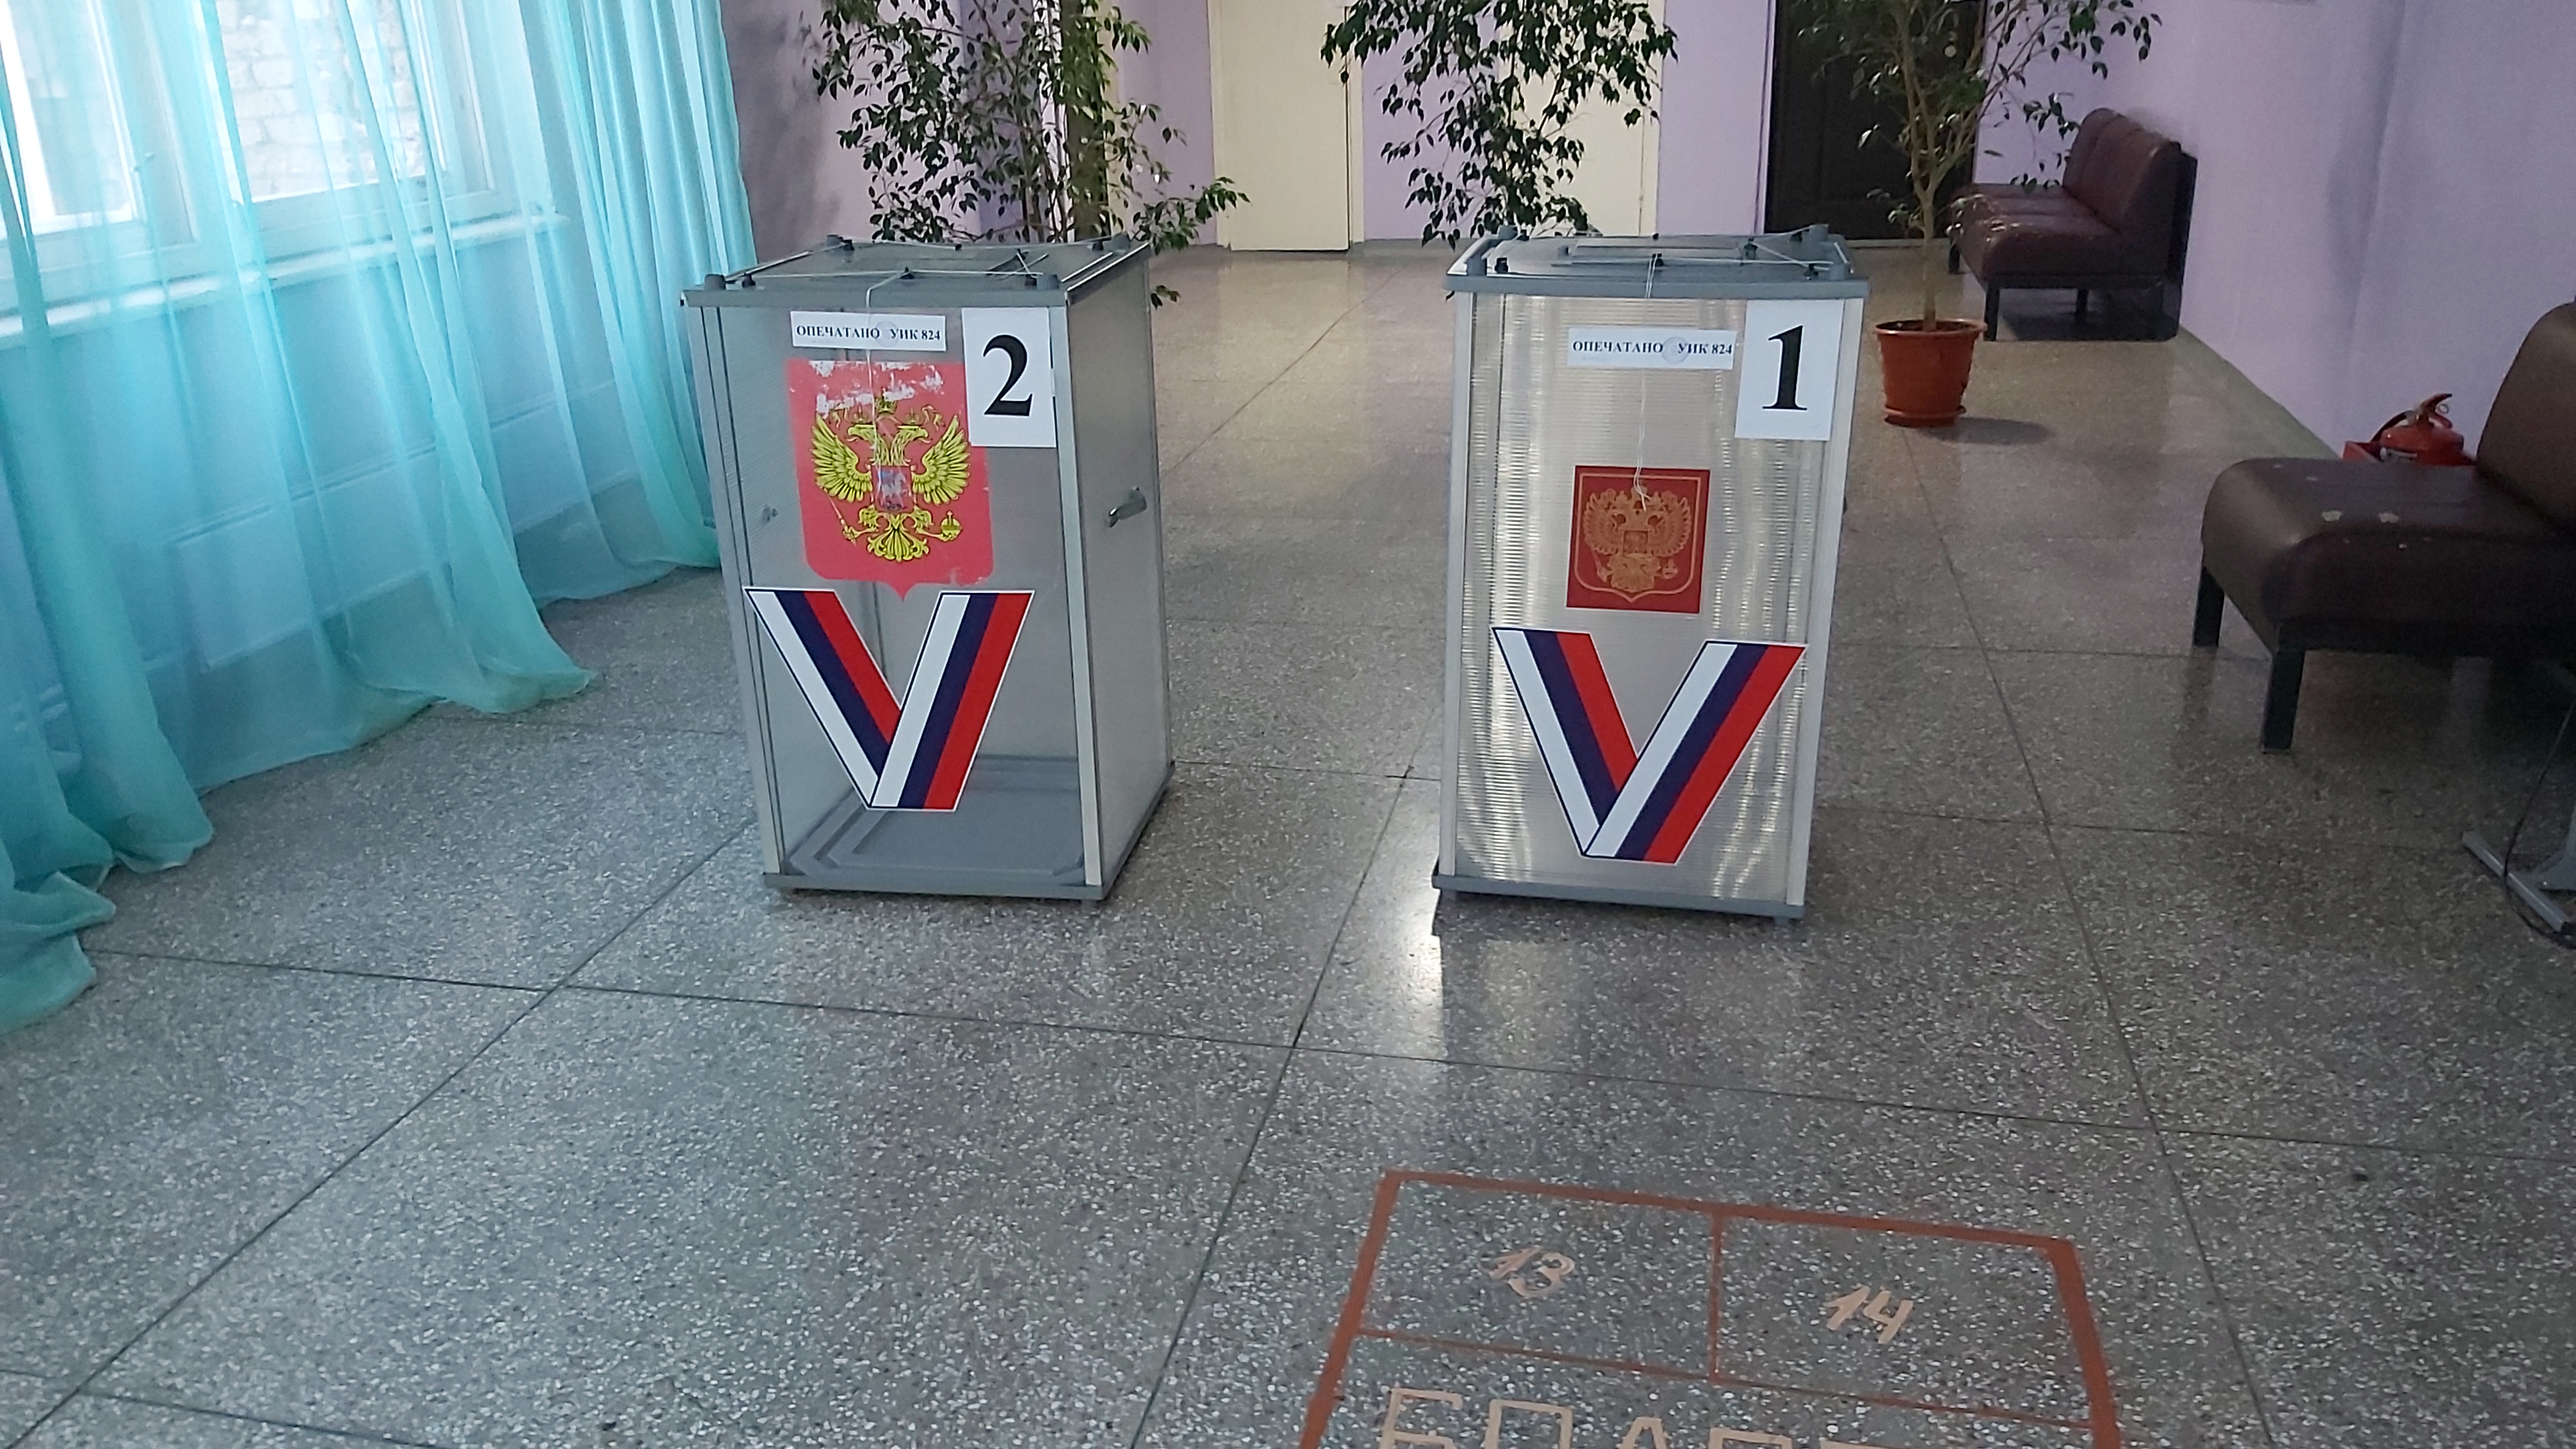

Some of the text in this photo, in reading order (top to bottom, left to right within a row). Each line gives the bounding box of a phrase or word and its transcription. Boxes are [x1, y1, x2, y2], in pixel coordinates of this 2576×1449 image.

[796, 325, 941, 341] ОПЕЧАТАНО УИК 824
[1572, 340, 1733, 355] ОПЕЧАТАНО УИК 824
[982, 334, 1033, 417] 2
[1761, 324, 1808, 411] 1
[1477, 1246, 1575, 1299] 13
[1822, 1283, 1914, 1344] 14
